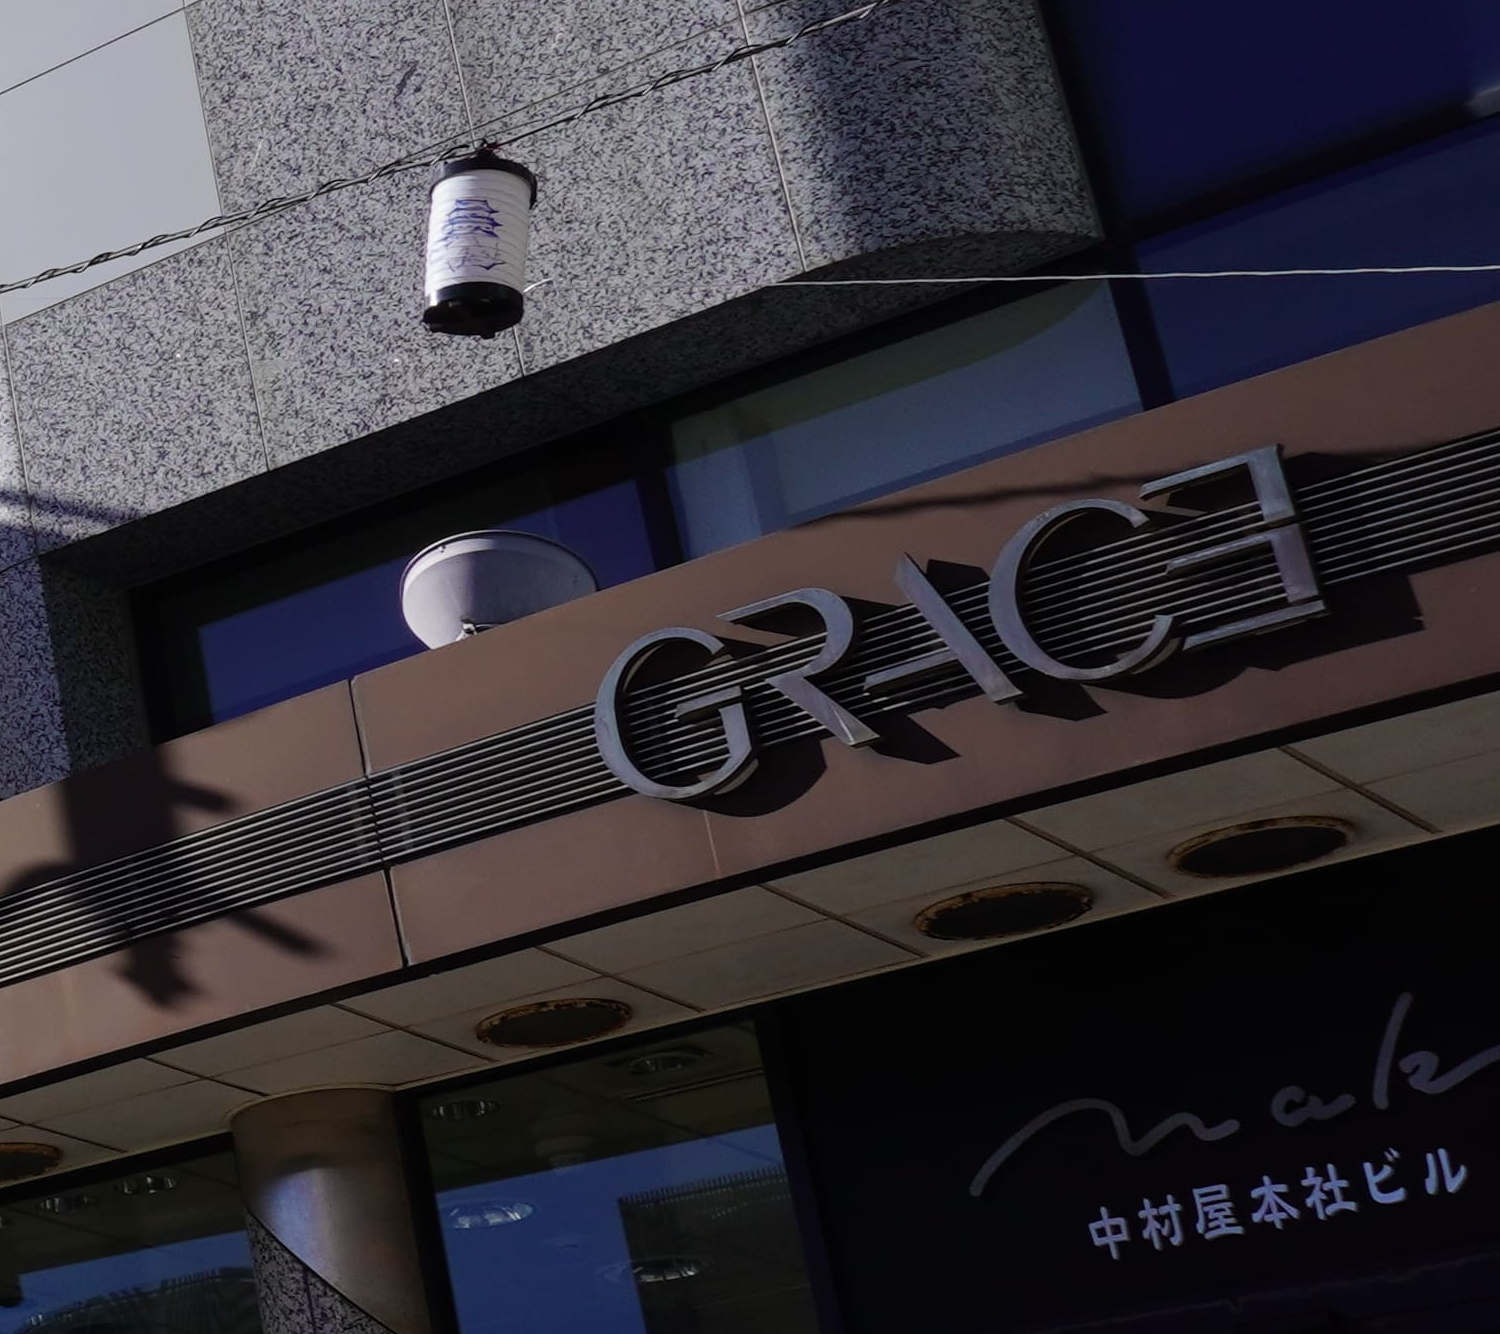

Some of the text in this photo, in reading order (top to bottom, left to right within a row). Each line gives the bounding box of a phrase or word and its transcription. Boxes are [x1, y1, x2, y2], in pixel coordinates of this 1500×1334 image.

[595, 443, 1326, 799] GRACE
[1088, 1147, 1468, 1259] 中村屋本社ビル
